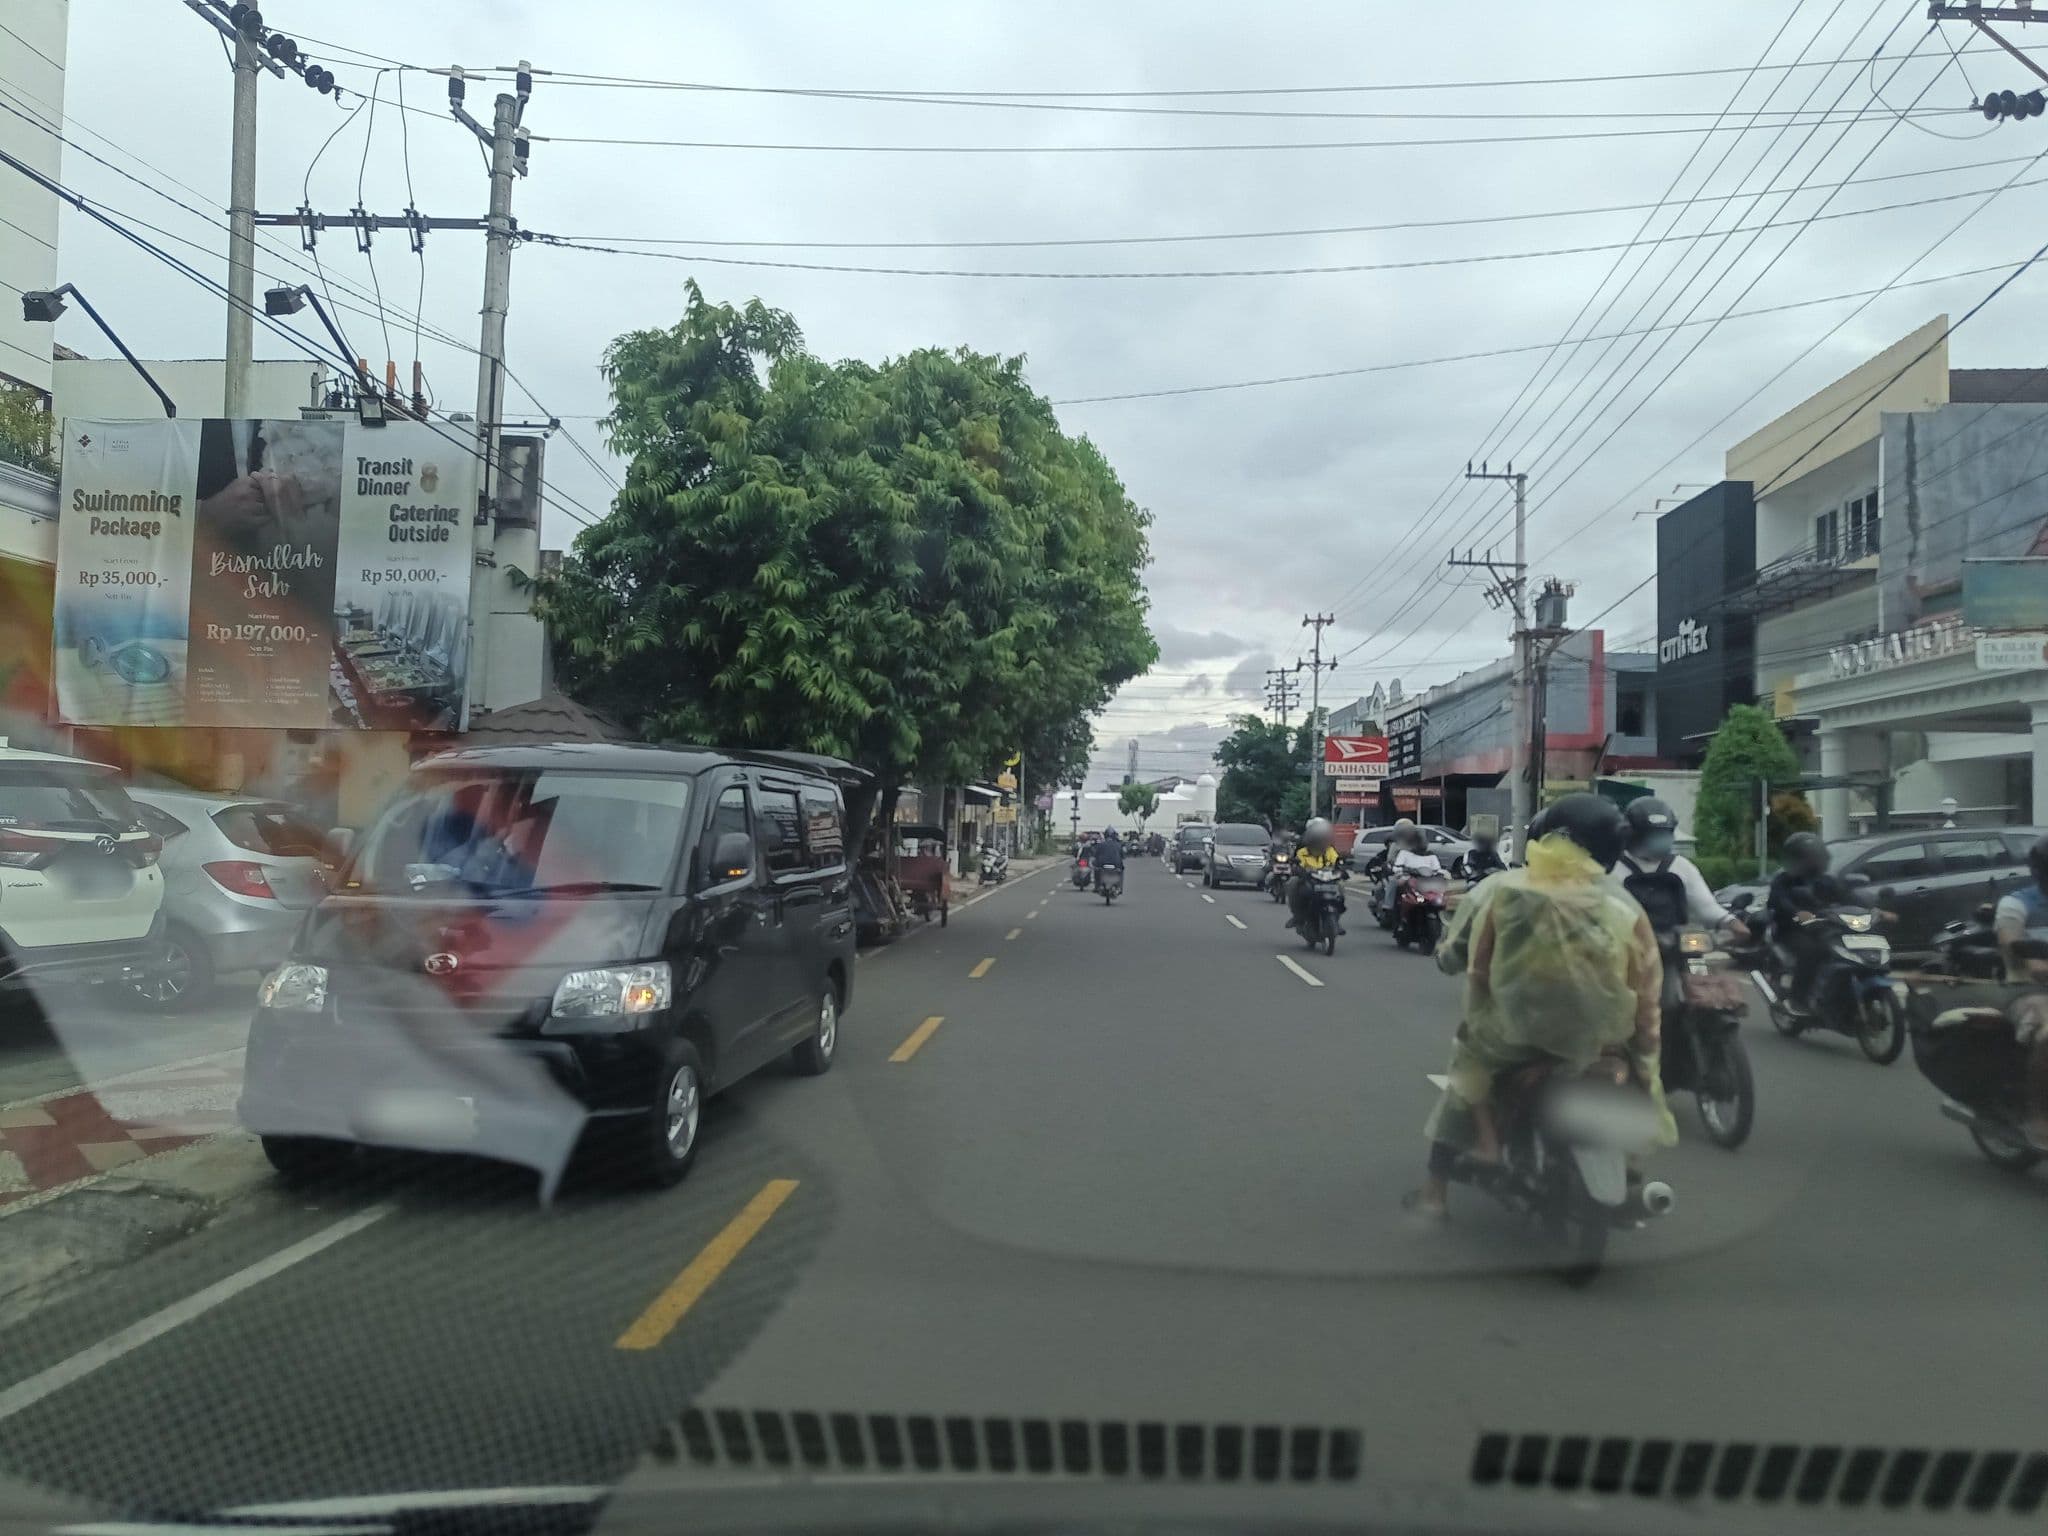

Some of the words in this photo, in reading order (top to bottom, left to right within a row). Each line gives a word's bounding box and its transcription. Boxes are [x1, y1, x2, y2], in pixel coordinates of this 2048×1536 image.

[357, 457, 413, 475] Transit
[357, 477, 411, 496] Dinner
[72, 488, 183, 517] Swimming
[390, 504, 460, 526] Catering
[90, 517, 162, 539] Package
[388, 524, 450, 542] Outside
[209, 543, 323, 576] Bismillah
[79, 571, 99, 587] Rp
[102, 571, 168, 588] 35,000,-
[244, 571, 290, 599] Sah
[361, 569, 382, 585] Rp
[384, 568, 447, 584] 50,000,-
[206, 624, 232, 644] Rp
[235, 624, 318, 645] 197,000,-
[1328, 763, 1386, 775] DAIHATSU
